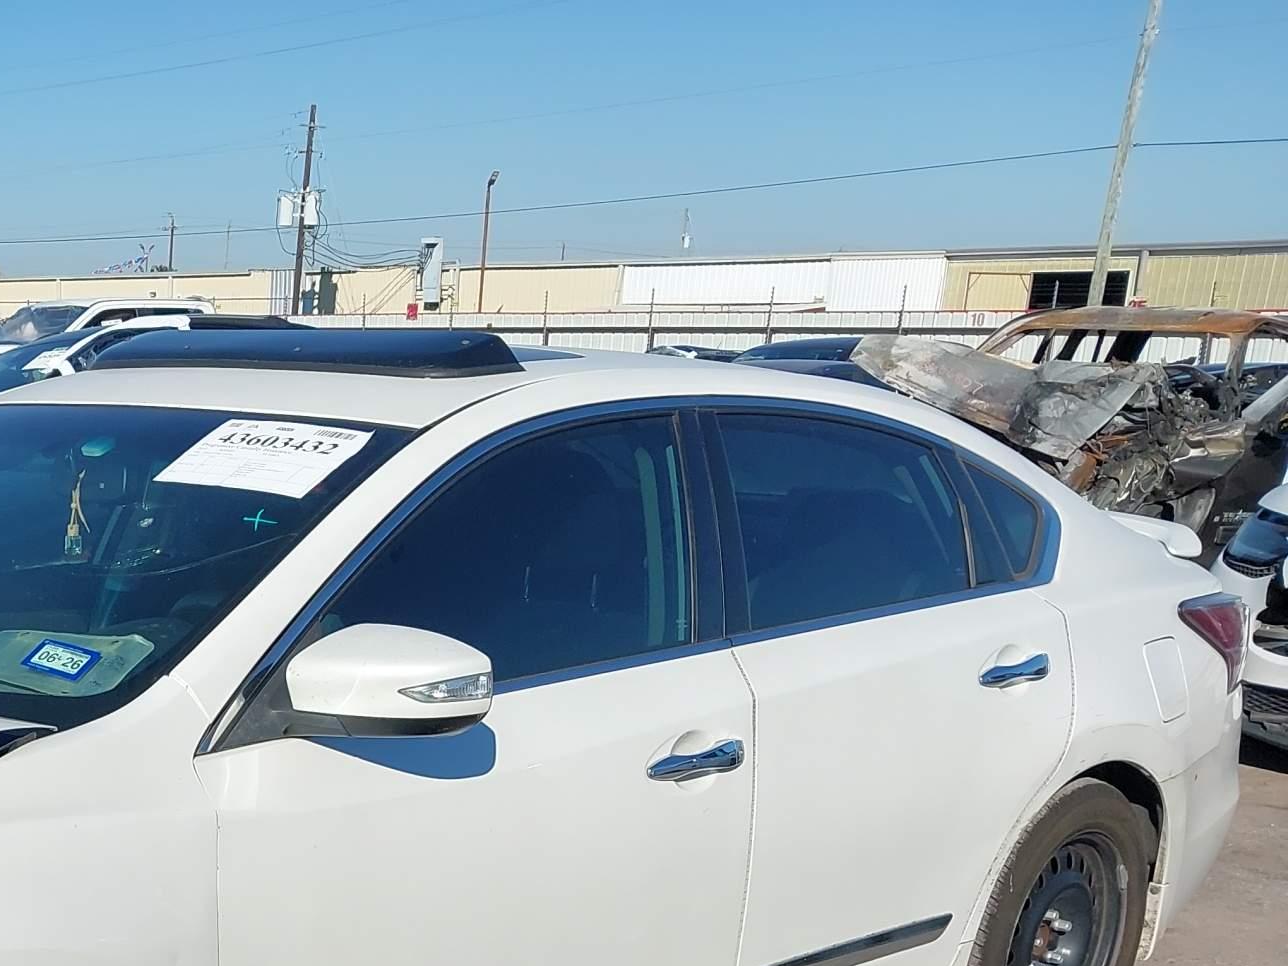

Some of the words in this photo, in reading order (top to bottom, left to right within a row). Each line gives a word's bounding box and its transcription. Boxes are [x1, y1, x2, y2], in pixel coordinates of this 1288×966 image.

[971, 312, 986, 327] 10
[218, 431, 340, 455] 43603432
[38, 650, 59, 663] 06
[61, 656, 85, 671] 26
